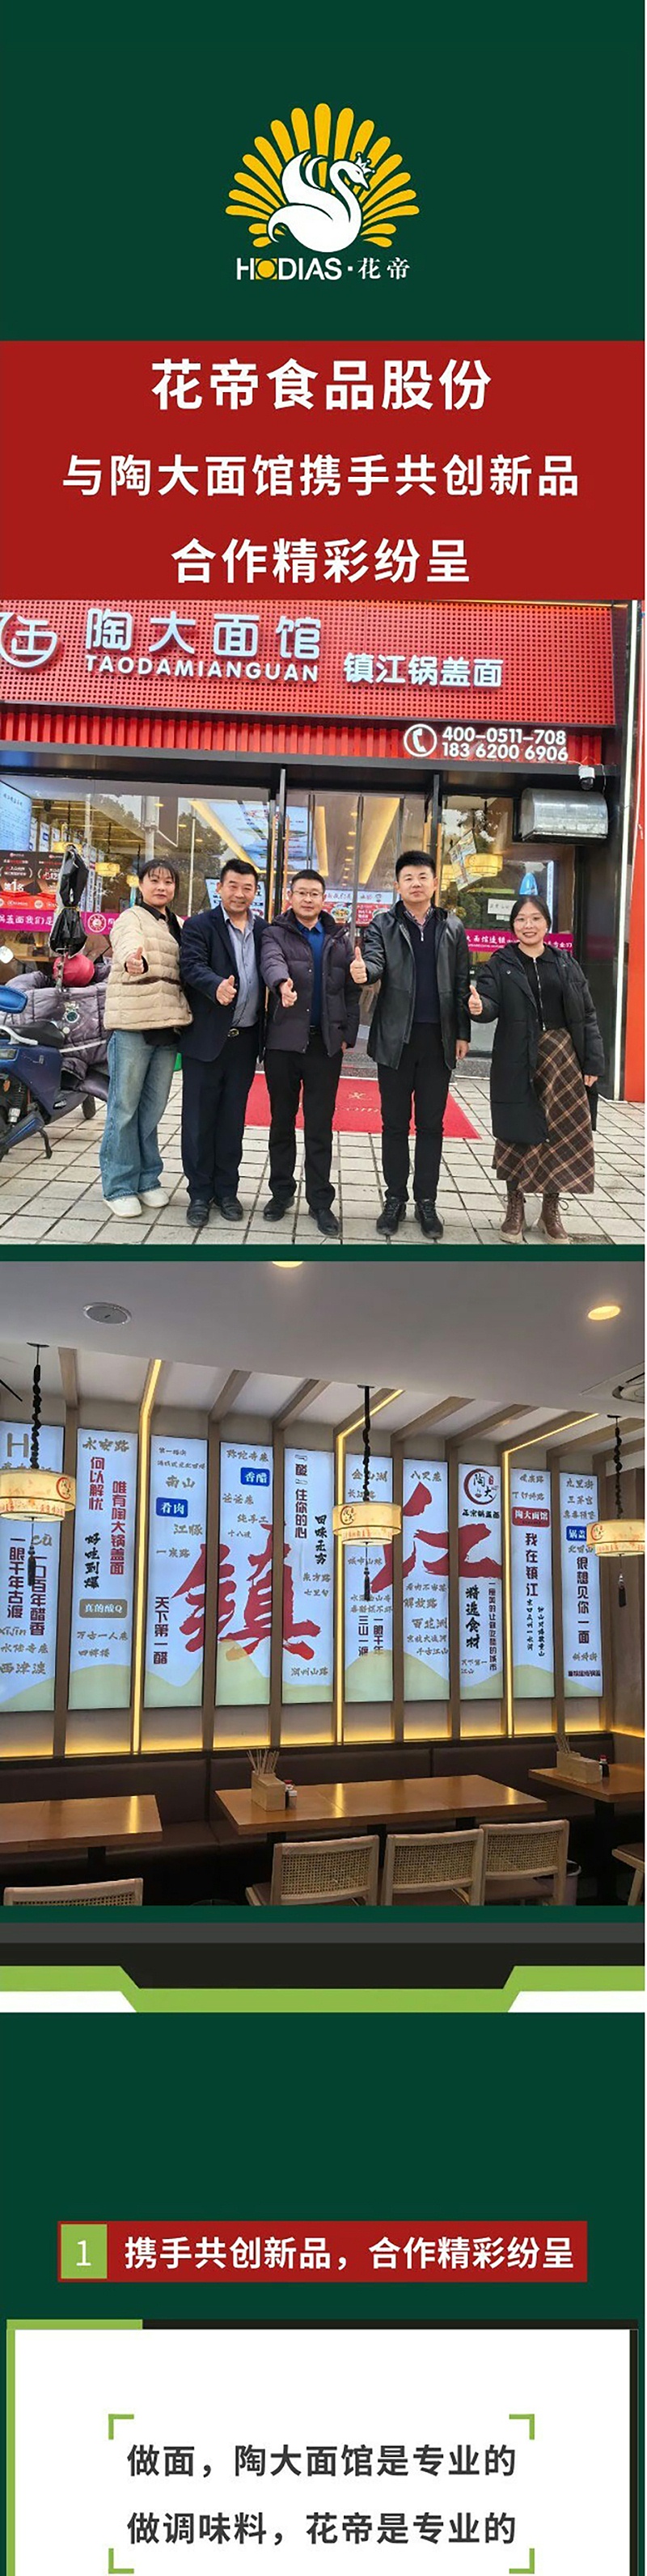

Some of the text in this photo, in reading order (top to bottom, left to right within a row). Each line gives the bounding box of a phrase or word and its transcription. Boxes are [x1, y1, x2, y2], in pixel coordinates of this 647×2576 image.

[87, 608, 321, 660] 陶大面馆
[85, 654, 318, 681] TAODAMIANGUAN
[343, 652, 503, 687] 镇江锅盖面
[442, 727, 566, 745] 400-0511-708
[442, 742, 569, 761] 183 6200 6906
[89, 1457, 105, 1511] 何以解忧
[110, 1481, 127, 1575] 唯有陶大锅盖面
[7, 1538, 26, 1619] 一眼千年古渡
[526, 1533, 539, 1596] 我在镇江
[465, 1584, 480, 1649] 精选食材
[577, 1556, 590, 1644] 很想见你一面
[154, 1596, 169, 1664] 天下第一醋
